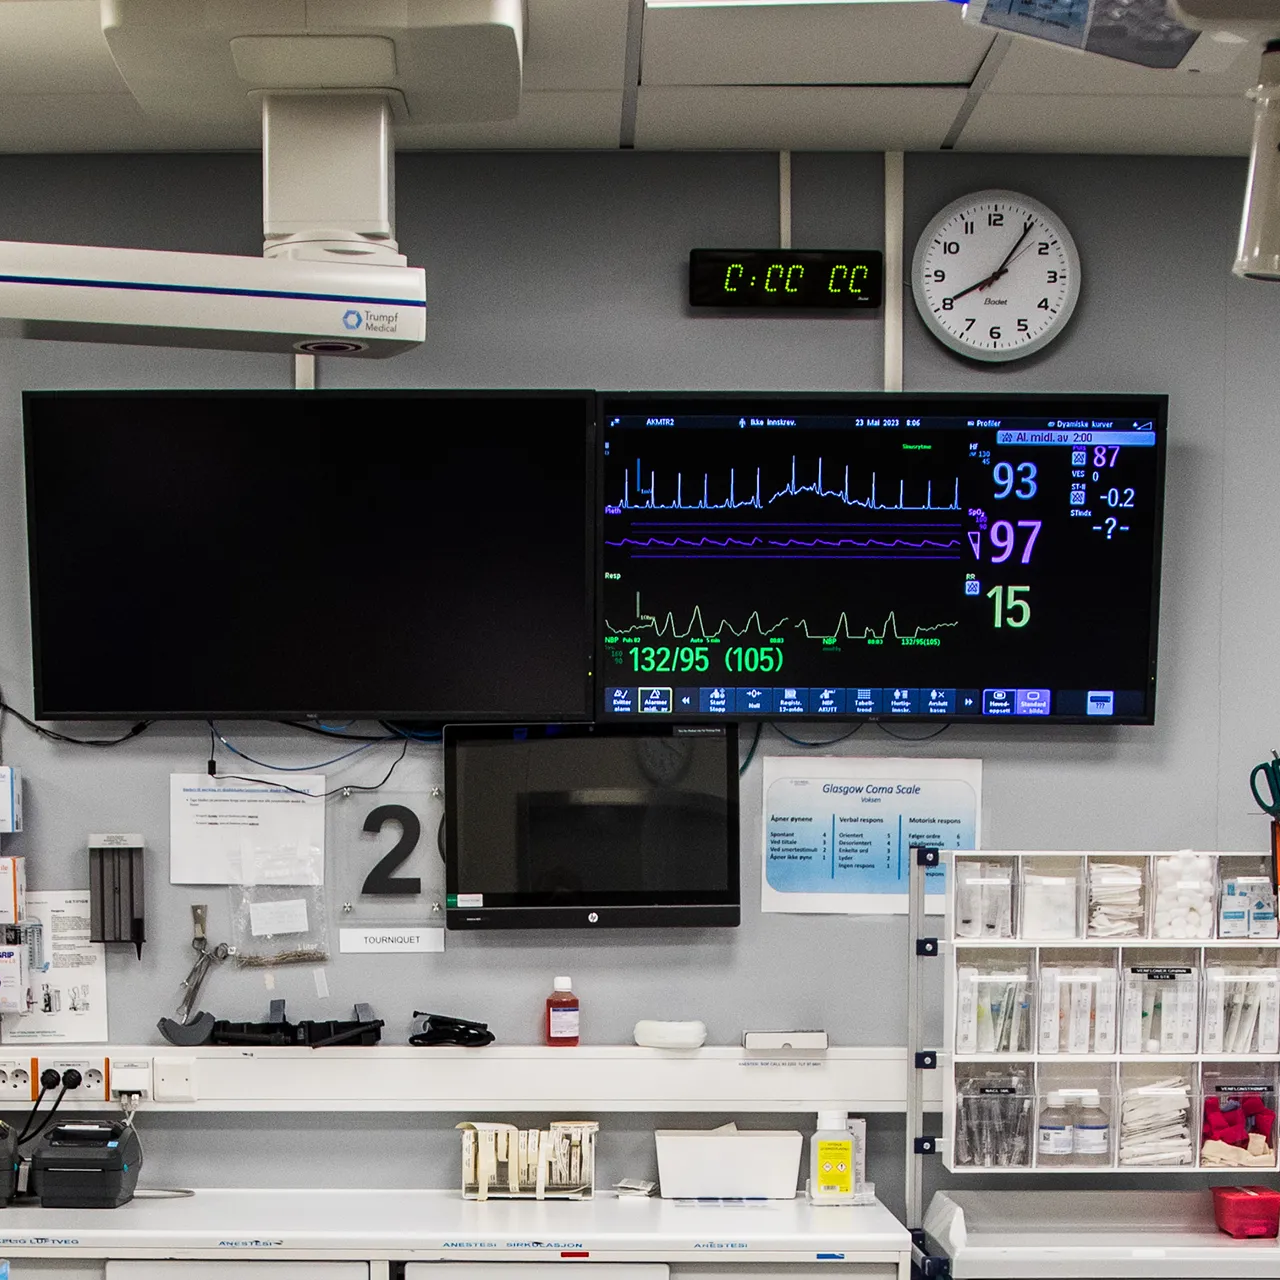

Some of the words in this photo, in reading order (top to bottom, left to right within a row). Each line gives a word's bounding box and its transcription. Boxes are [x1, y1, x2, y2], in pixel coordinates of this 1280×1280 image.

[988, 214, 1004, 226] 12
[964, 222, 974, 234] 11
[943, 242, 960, 254] 10
[1037, 243, 1049, 255] 2
[934, 270, 945, 282] 9
[1047, 271, 1058, 283] 3
[942, 298, 953, 310] 8
[984, 298, 1008, 306] Bodet
[1037, 298, 1049, 310] 4
[365, 310, 399, 324] Trumpf
[365, 323, 397, 333] Medical
[965, 319, 975, 331] 7
[1017, 319, 1028, 331] 5
[990, 326, 1001, 339] 6
[646, 418, 675, 427] AKMTR2
[750, 418, 764, 426] Ikke
[855, 419, 864, 427] 23
[883, 419, 900, 427] 2023
[906, 419, 921, 427] 8:06
[1016, 433, 1029, 443] Al.
[1031, 433, 1055, 443] midl.
[1057, 434, 1069, 443] av
[1073, 433, 1093, 443] 2:00
[1093, 445, 1120, 468] 87
[1072, 470, 1085, 478] VES
[1092, 471, 1099, 482] 0
[993, 462, 1038, 500] 93
[1100, 488, 1135, 508] -0.2
[605, 507, 622, 515] Pleth
[990, 520, 1042, 564] 97
[605, 572, 622, 581] Resp
[966, 573, 976, 581] RR
[986, 585, 1031, 628] 15
[629, 647, 710, 673] 132/95
[725, 647, 783, 673] (105)
[822, 784, 864, 796] Glasgow
[866, 785, 893, 794] Coma
[896, 784, 921, 795] Scale
[771, 815, 789, 823] Åpner
[362, 804, 421, 894] 2
[364, 936, 420, 944] TOURNIQUET
